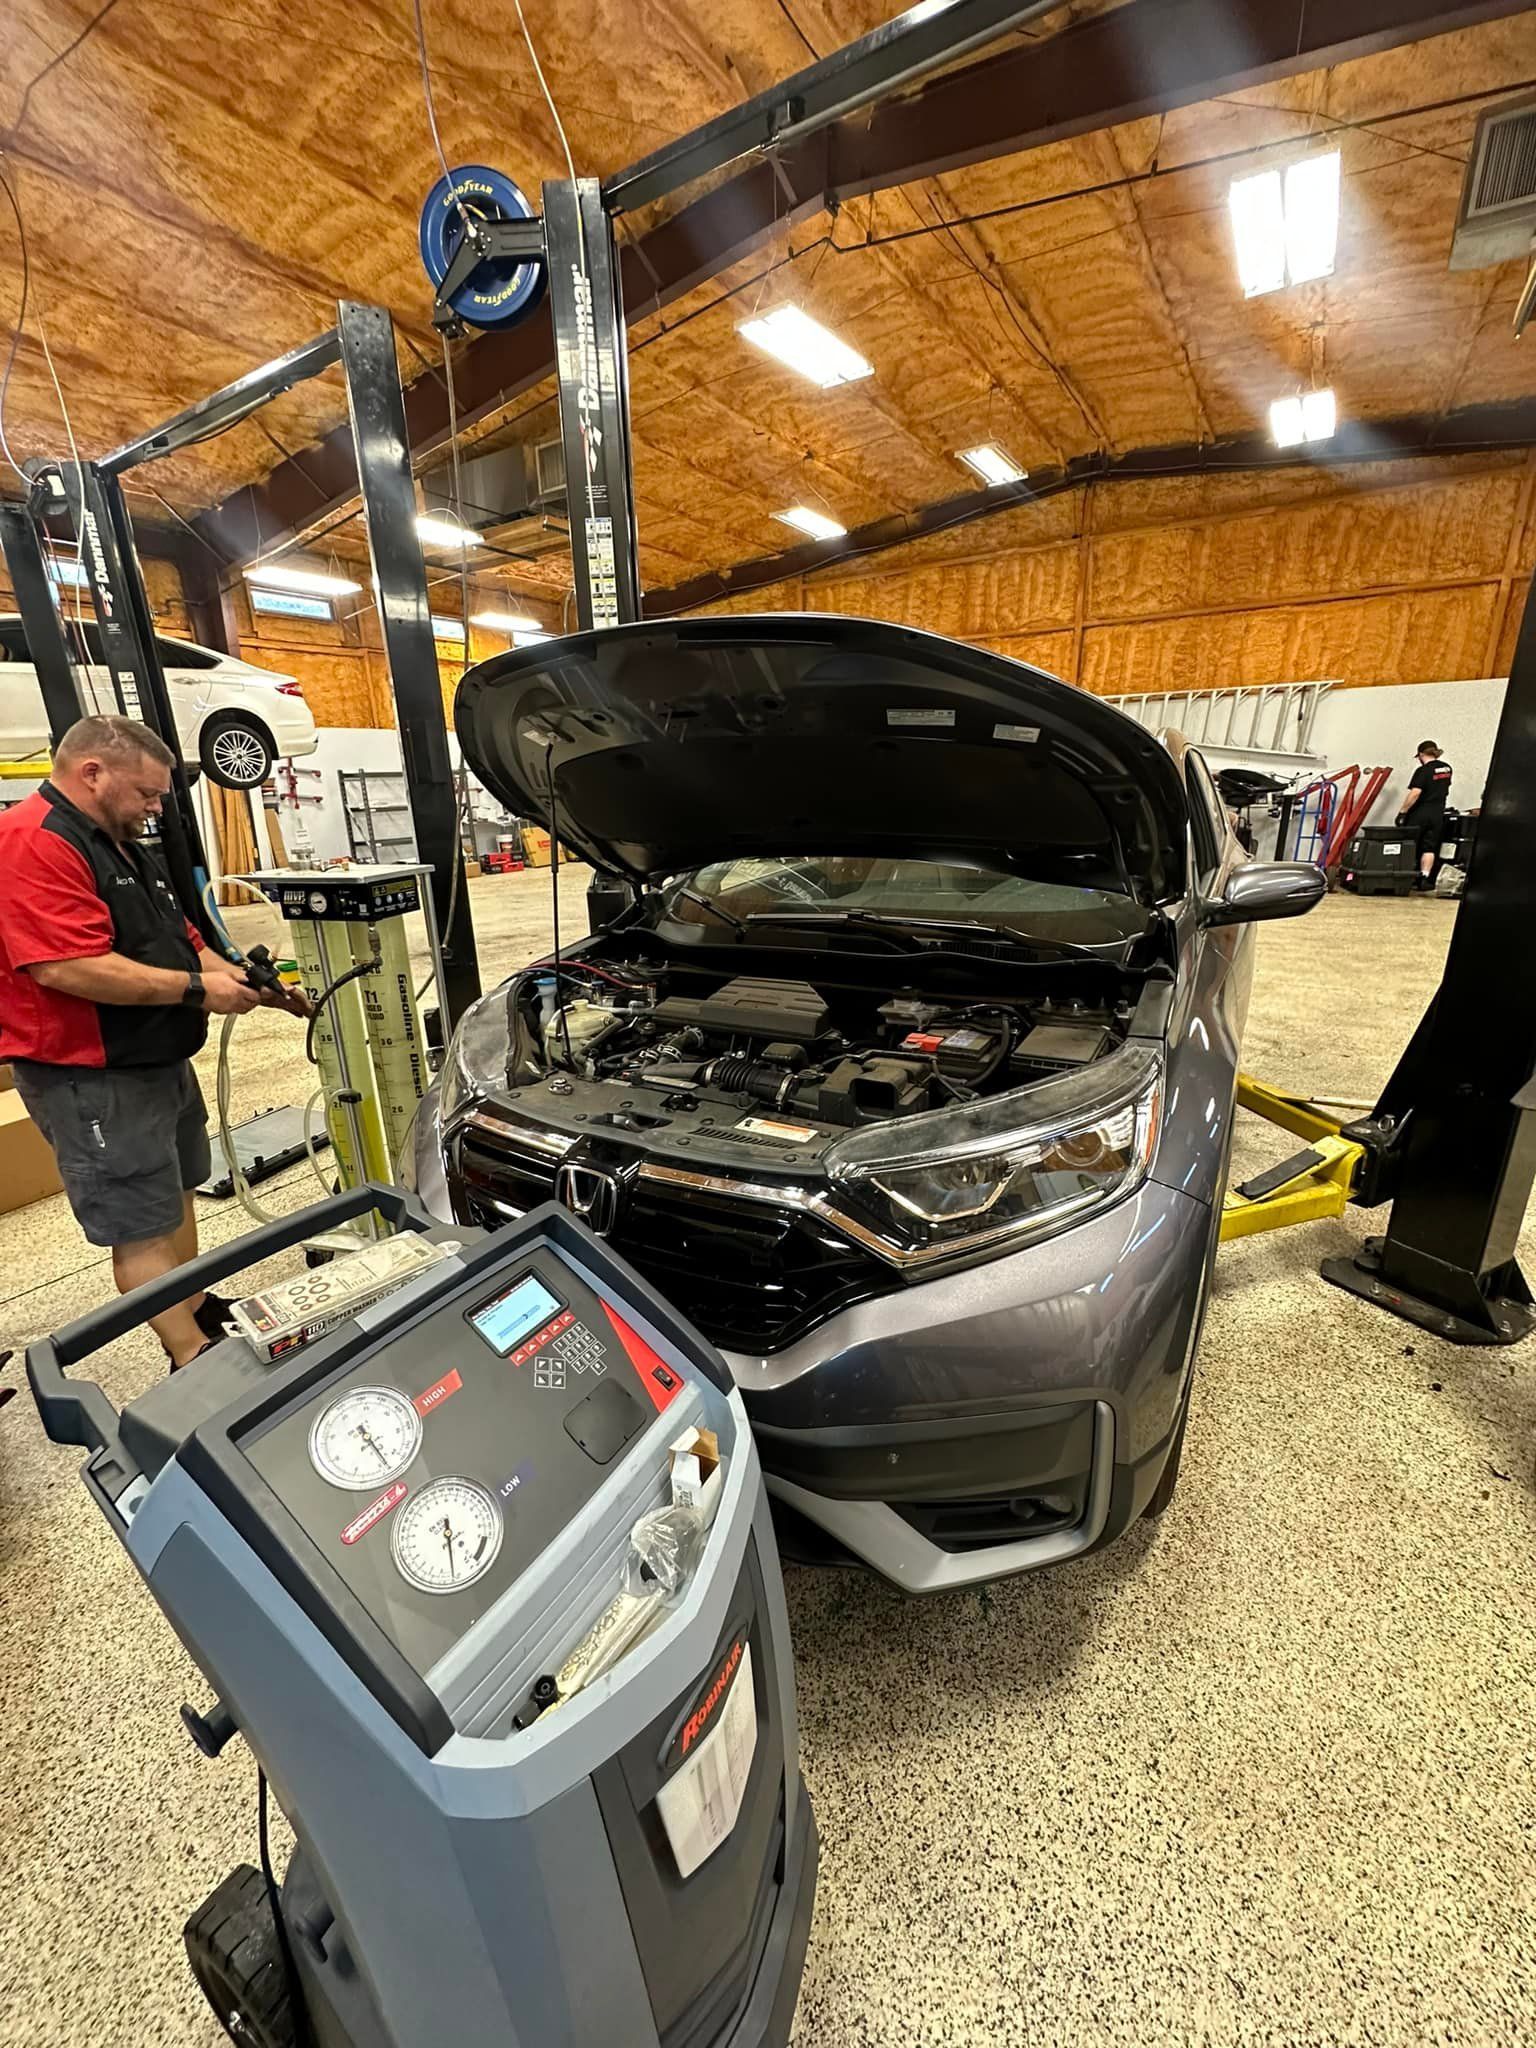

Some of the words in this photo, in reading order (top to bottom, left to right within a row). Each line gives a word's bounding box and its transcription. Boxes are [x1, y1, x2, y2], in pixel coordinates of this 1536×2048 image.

[443, 180, 493, 206] GOODYEAR
[474, 277, 520, 306] GOODYEAR
[304, 987, 320, 1001] T2
[364, 990, 378, 1003] T1
[397, 974, 415, 1041] Gasoline
[410, 1053, 424, 1099] Diesel
[422, 1385, 446, 1407] HIGH
[500, 1475, 521, 1497] LOW
[682, 1641, 742, 1754] ROBINAIR
